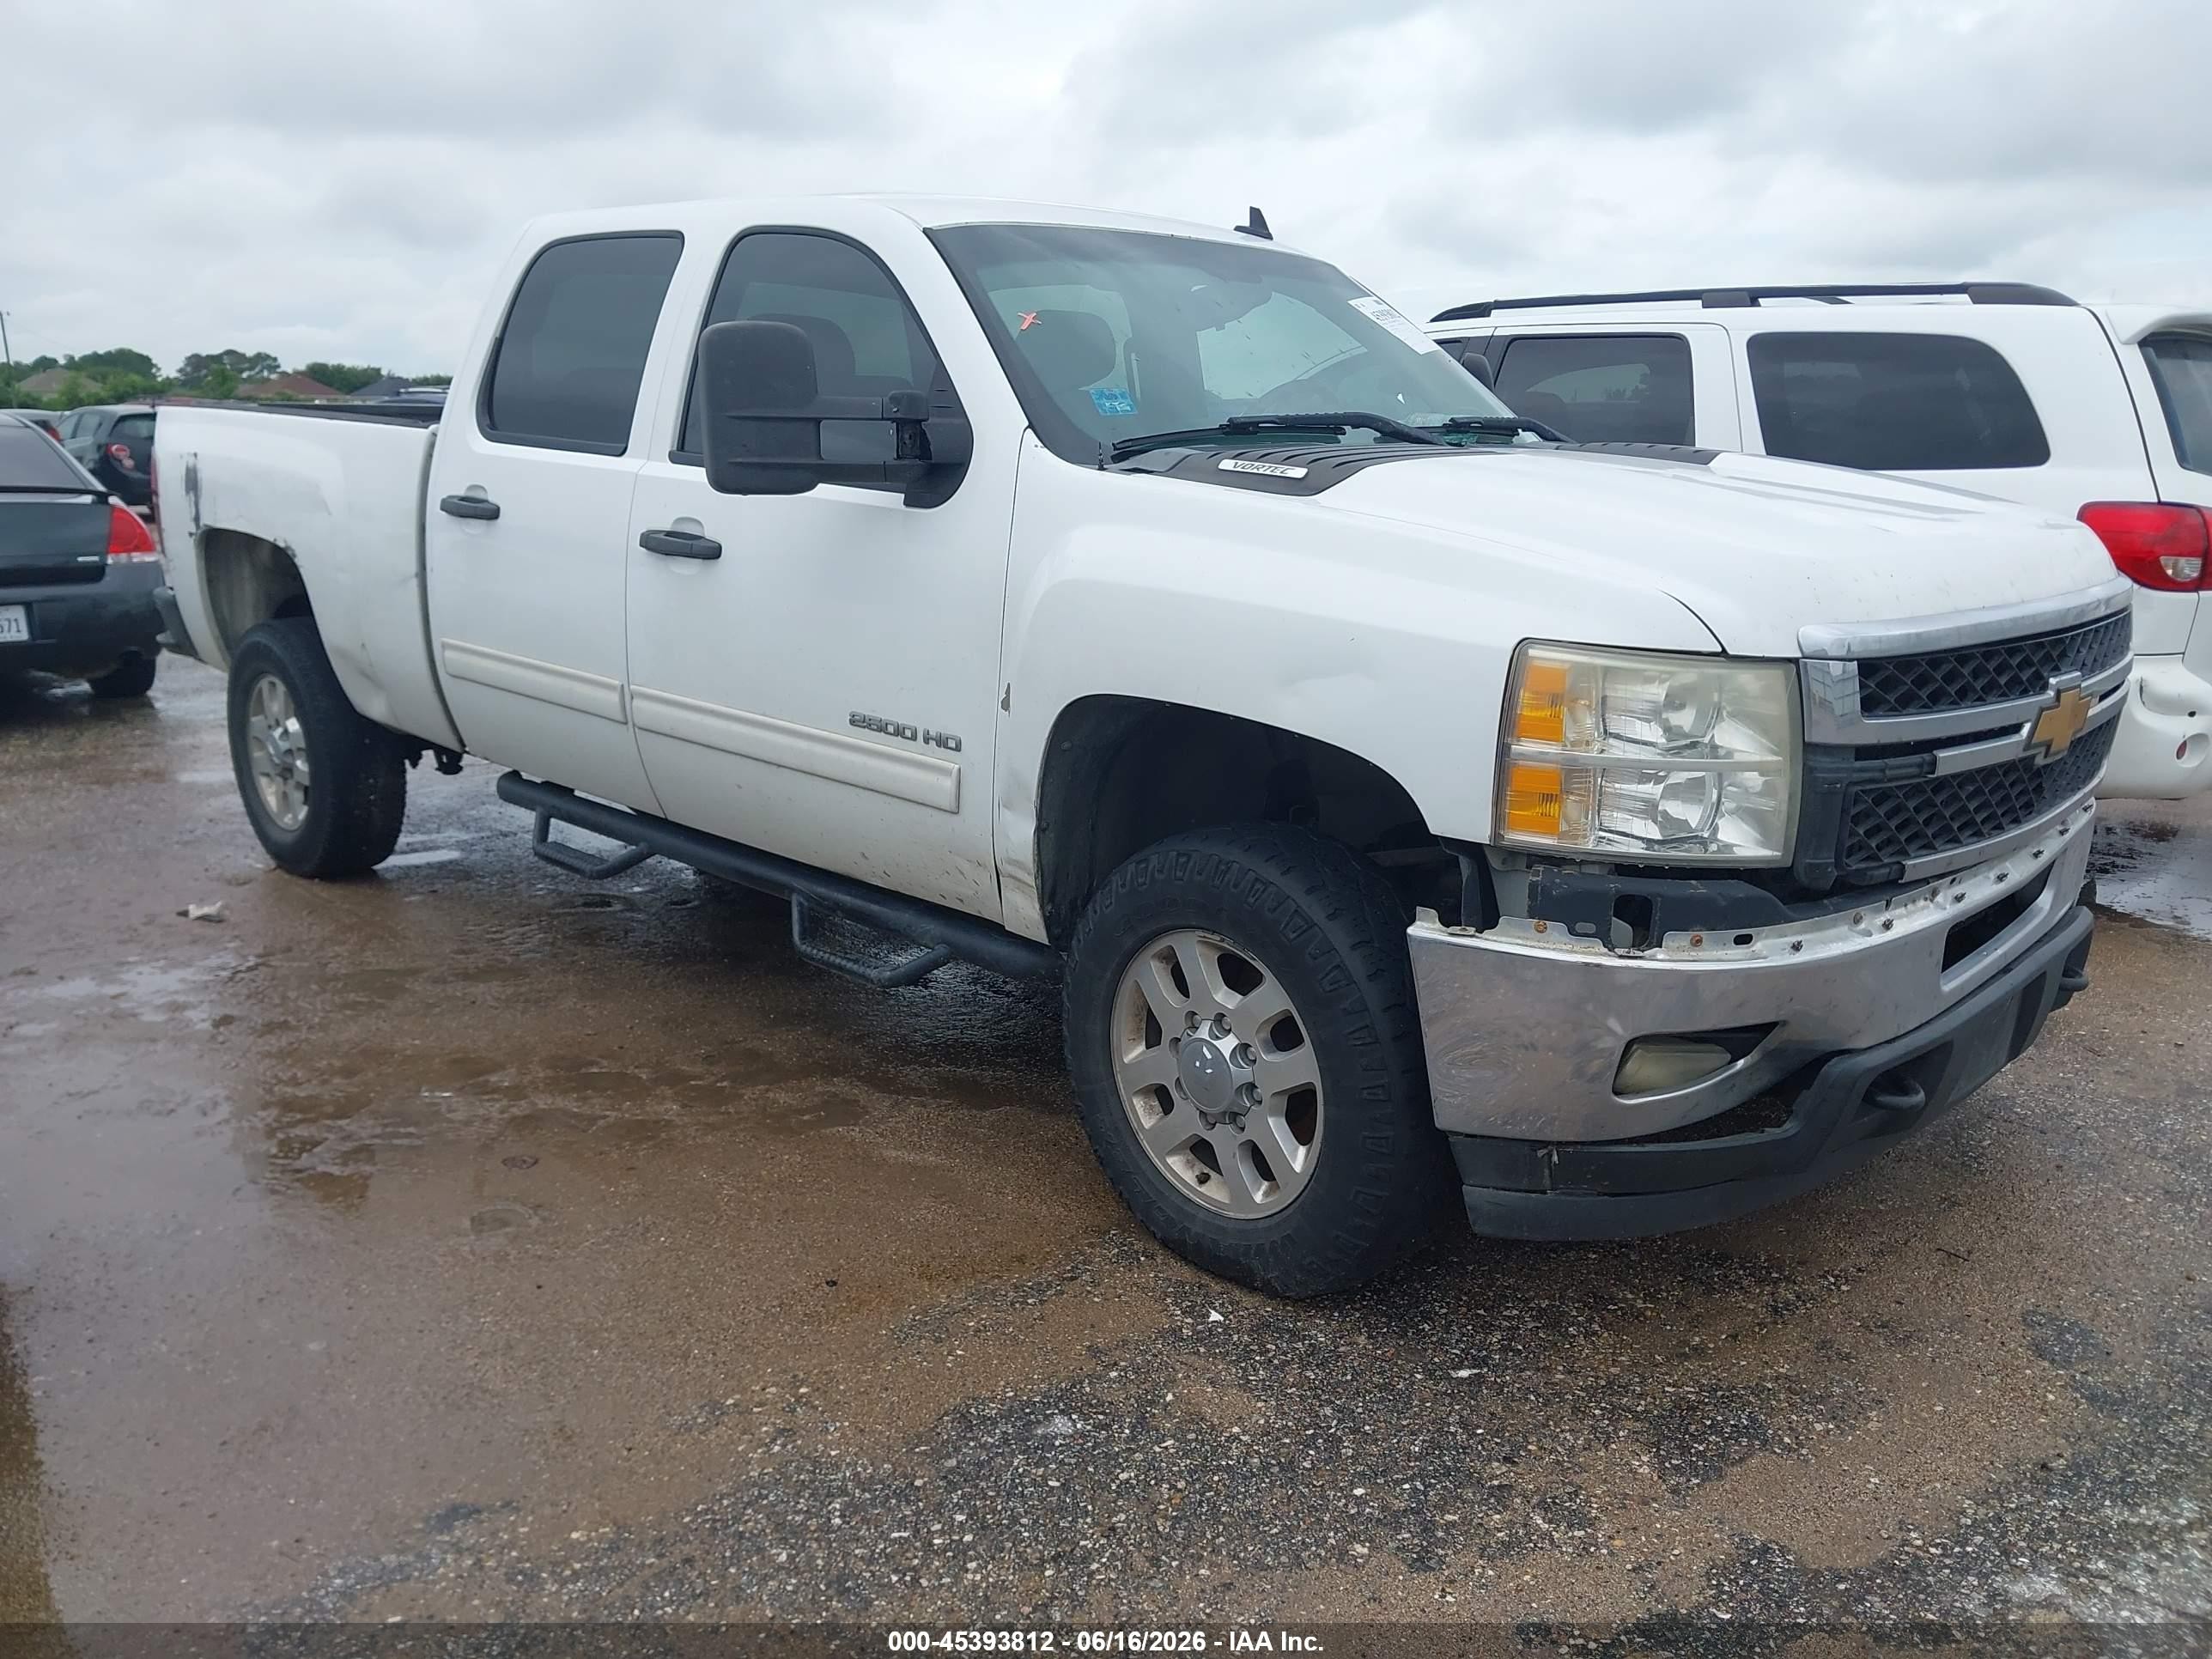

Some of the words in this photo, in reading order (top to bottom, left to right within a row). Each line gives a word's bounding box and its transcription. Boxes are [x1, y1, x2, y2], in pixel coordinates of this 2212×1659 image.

[1232, 461, 1296, 475] VORTEC
[848, 711, 918, 742] 2500
[922, 727, 962, 752] HD
